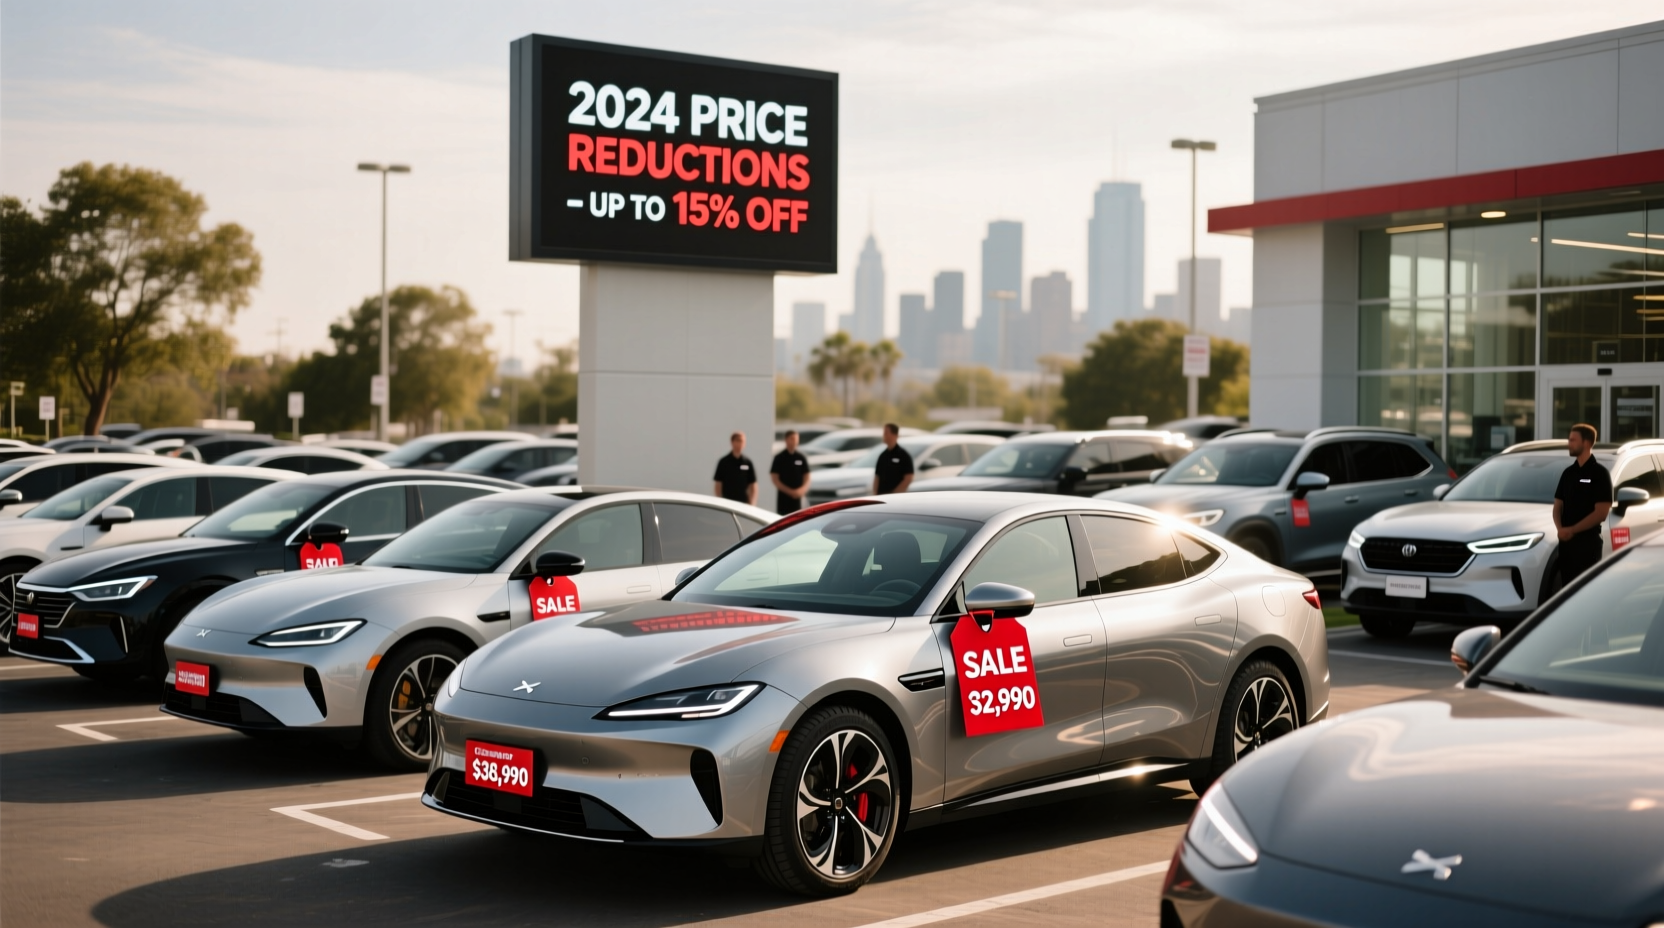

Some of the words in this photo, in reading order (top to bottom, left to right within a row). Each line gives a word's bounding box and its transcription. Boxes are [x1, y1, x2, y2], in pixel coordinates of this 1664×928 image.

[568, 80, 680, 134] 2024
[690, 94, 809, 147] PRICE
[568, 133, 810, 191] REDUCTIONS
[589, 191, 625, 218] UP
[629, 194, 666, 222] TO
[672, 191, 740, 229] 15%
[746, 196, 809, 233] OFF
[536, 594, 576, 614] SALE
[962, 645, 1028, 679] SALE
[472, 757, 529, 787] $38,990
